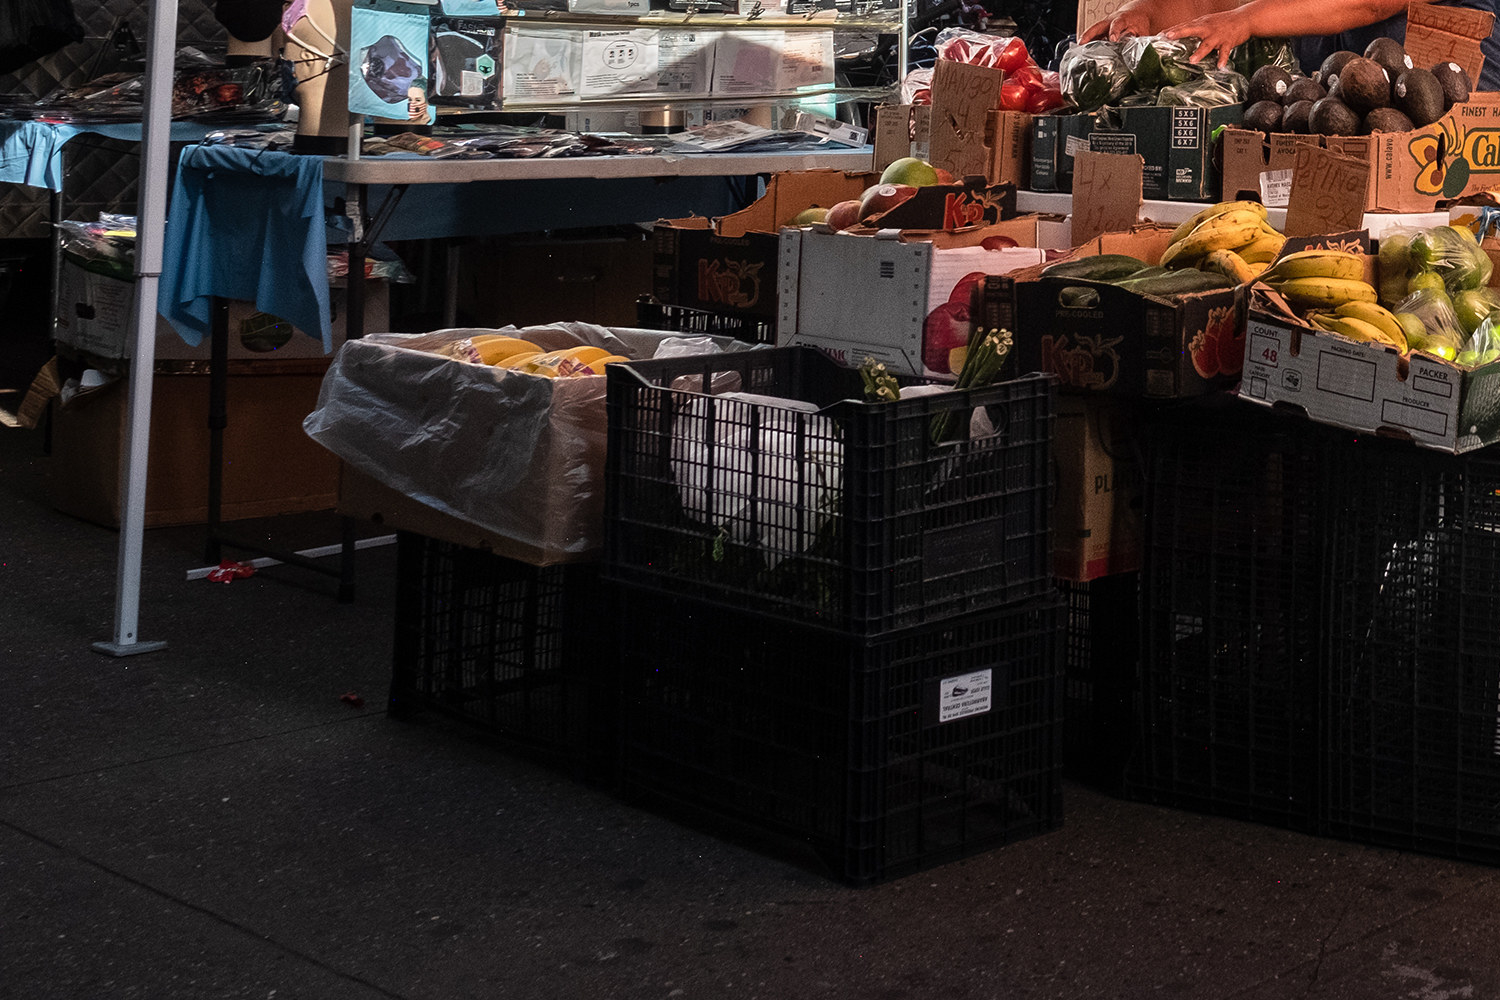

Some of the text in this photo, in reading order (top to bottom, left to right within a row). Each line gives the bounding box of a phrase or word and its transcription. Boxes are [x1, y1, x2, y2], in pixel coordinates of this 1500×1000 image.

[1462, 107, 1487, 116] FINEST
[1254, 326, 1278, 338] COUNT
[1261, 348, 1277, 363] 48
[1419, 366, 1449, 381] PACKER
